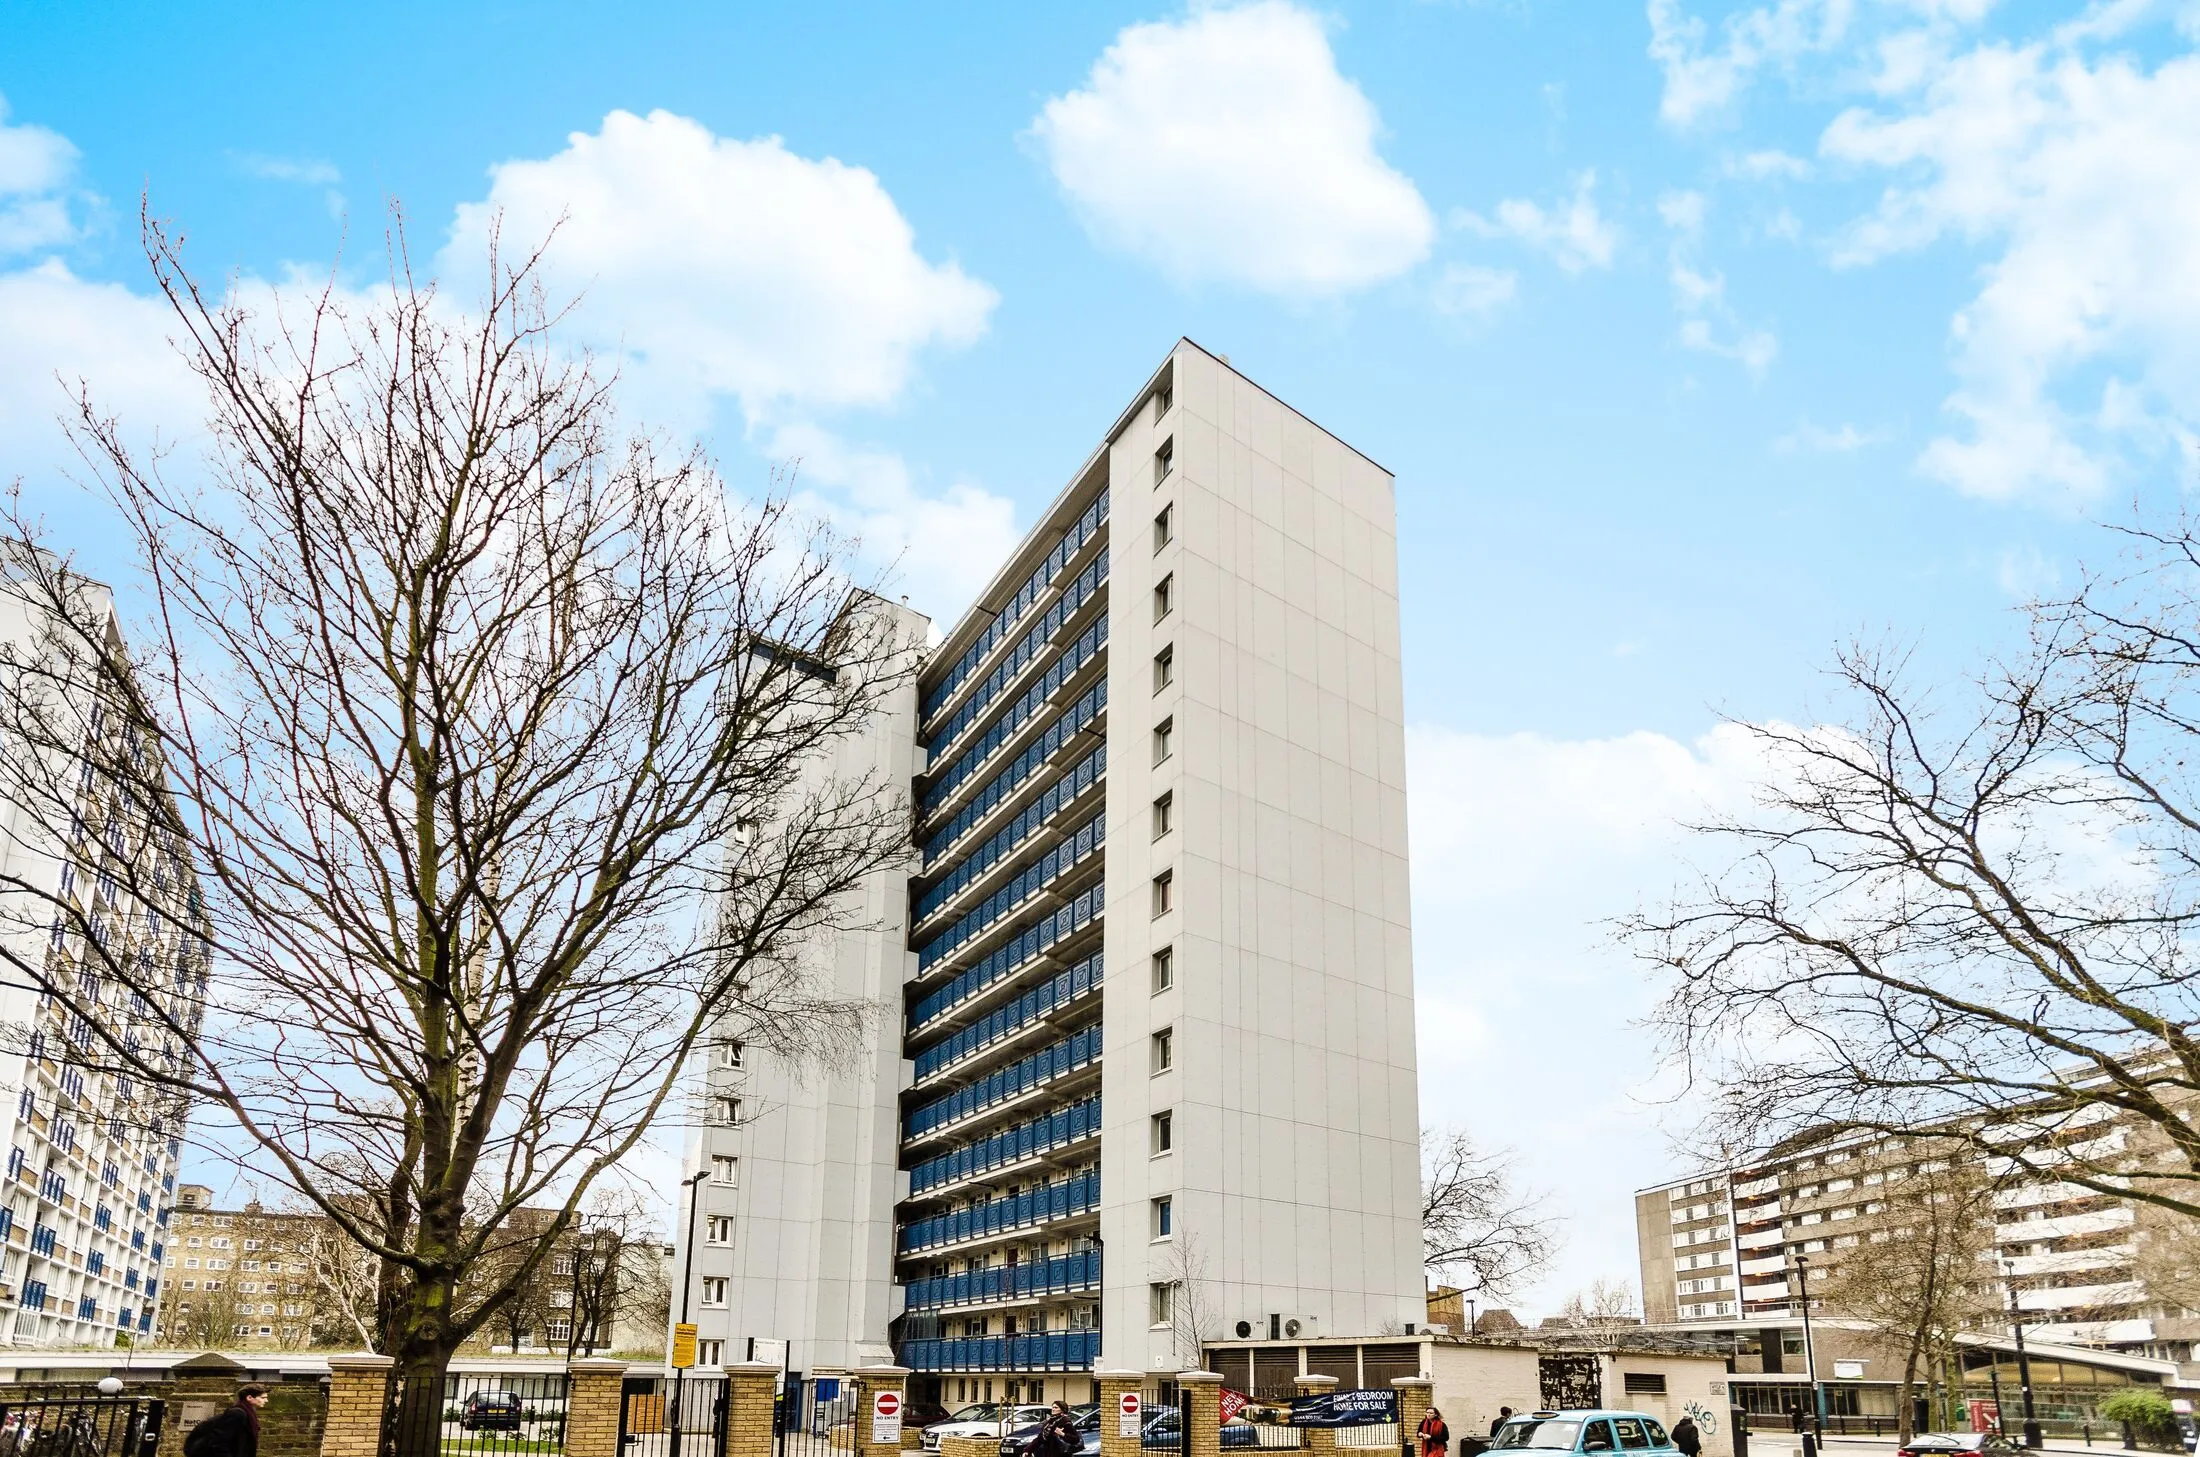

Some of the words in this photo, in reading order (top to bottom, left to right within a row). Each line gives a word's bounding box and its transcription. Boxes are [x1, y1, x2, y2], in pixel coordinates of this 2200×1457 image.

[1356, 1391, 1394, 1401] BEDROOM
[1333, 1402, 1353, 1411] HOME
[1353, 1401, 1370, 1410] FOR
[1370, 1401, 1387, 1410] SALE
